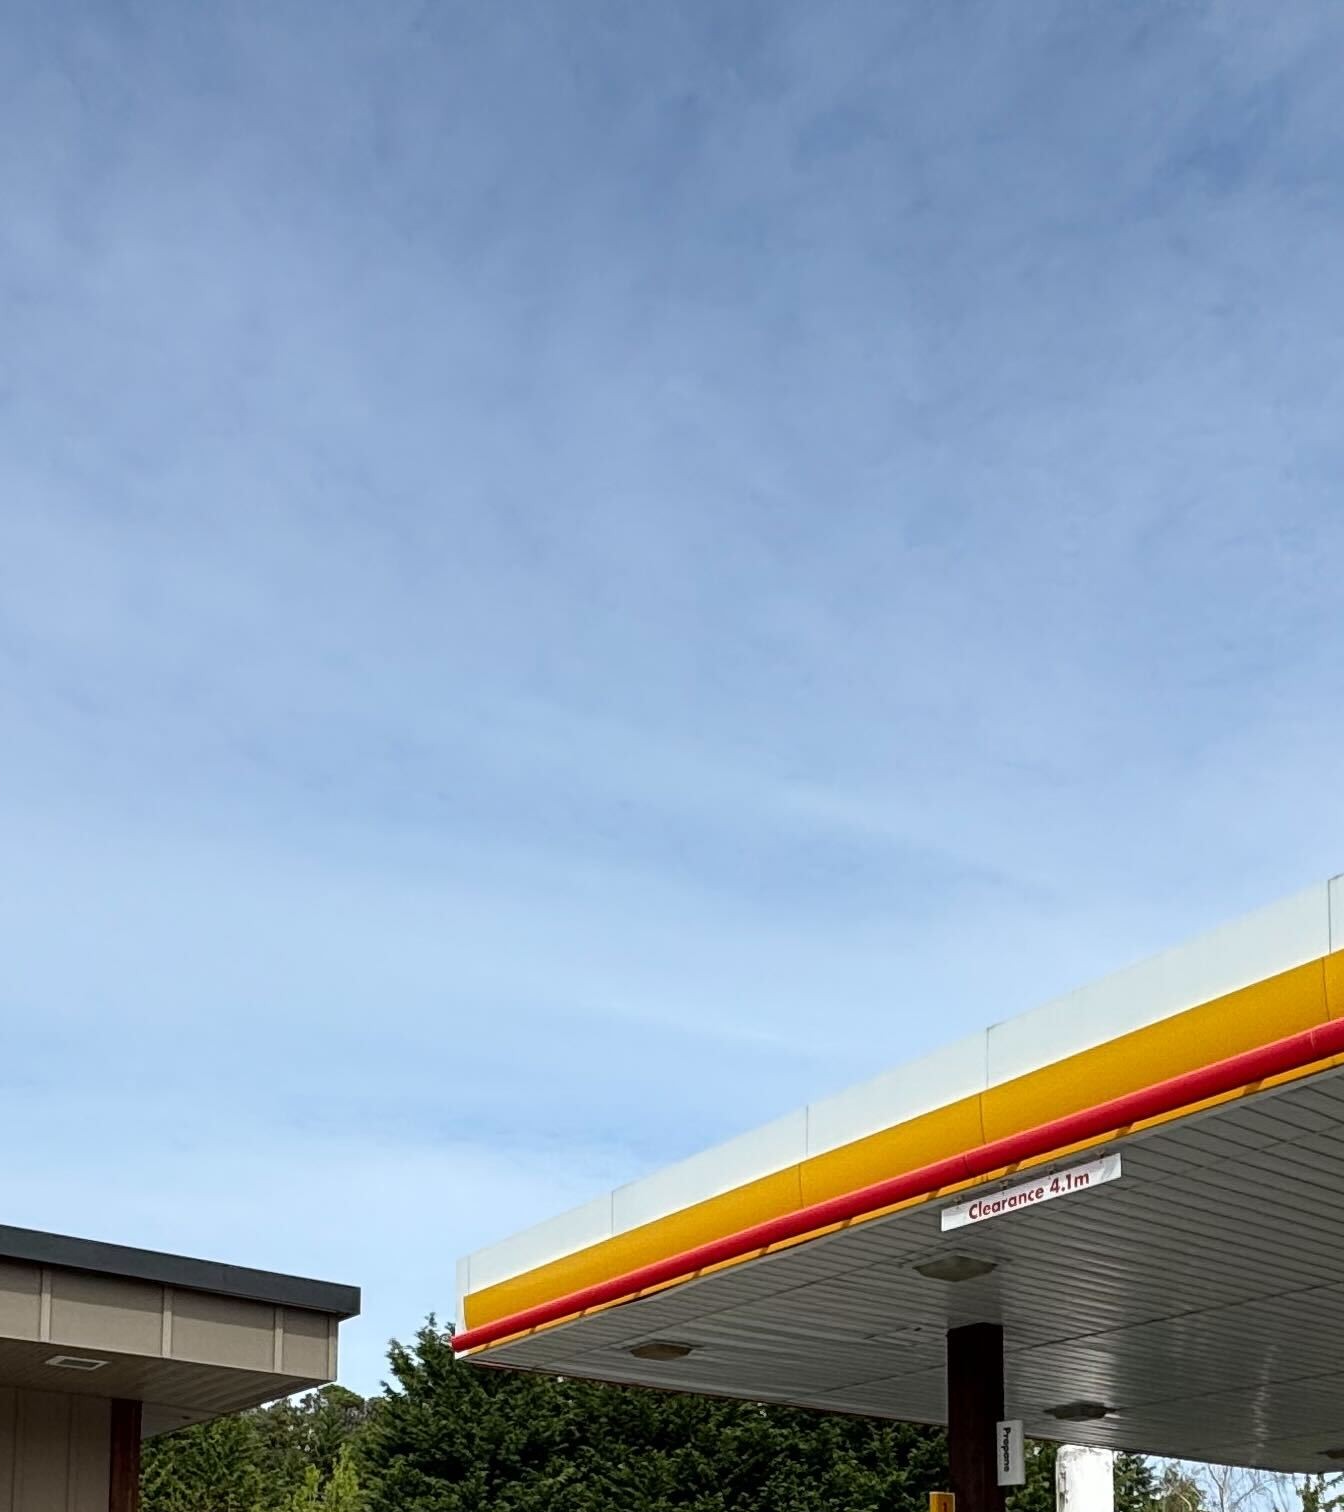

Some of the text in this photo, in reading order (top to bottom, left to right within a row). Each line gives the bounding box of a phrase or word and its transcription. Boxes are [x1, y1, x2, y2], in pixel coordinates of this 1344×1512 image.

[968, 1172, 1090, 1220] Clearance 4.1m
[1001, 1427, 1012, 1473] Propane
